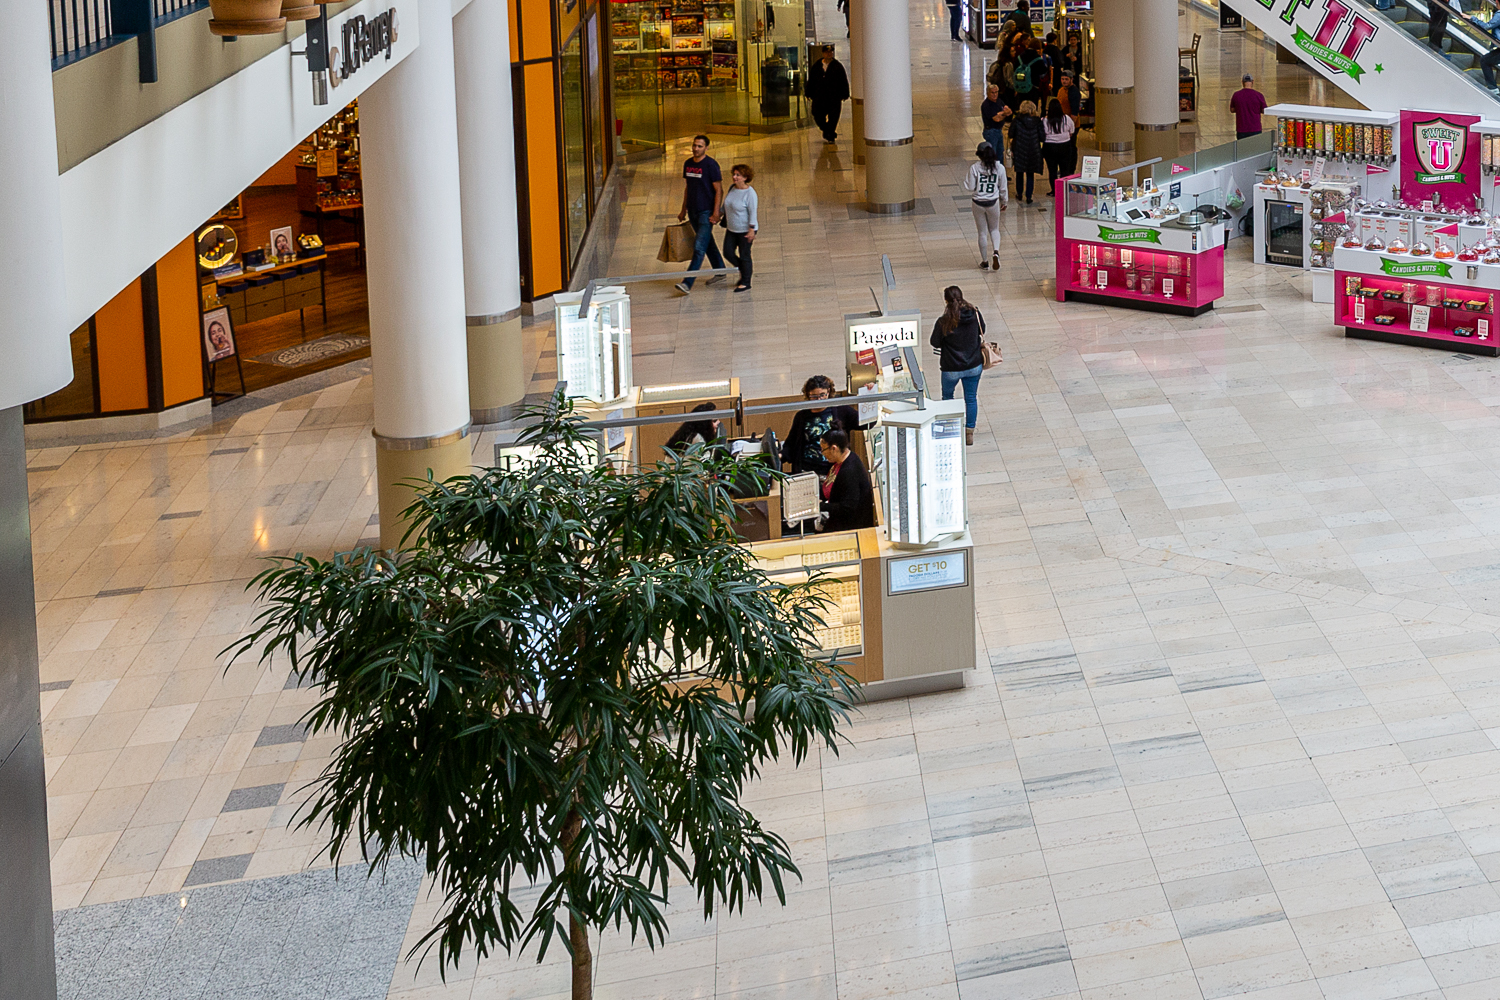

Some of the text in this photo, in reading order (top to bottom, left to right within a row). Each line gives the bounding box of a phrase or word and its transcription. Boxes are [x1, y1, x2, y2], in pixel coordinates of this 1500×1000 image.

[342, 9, 392, 79] JCPenney
[1301, 39, 1329, 58] CANDIES
[1333, 56, 1351, 70] NUTS
[1422, 128, 1461, 142] SWEET
[1427, 139, 1455, 172] U
[1100, 202, 1110, 215] A
[853, 327, 915, 346] Pagoda
[861, 404, 876, 415] OFF
[908, 561, 948, 574] GET $10
